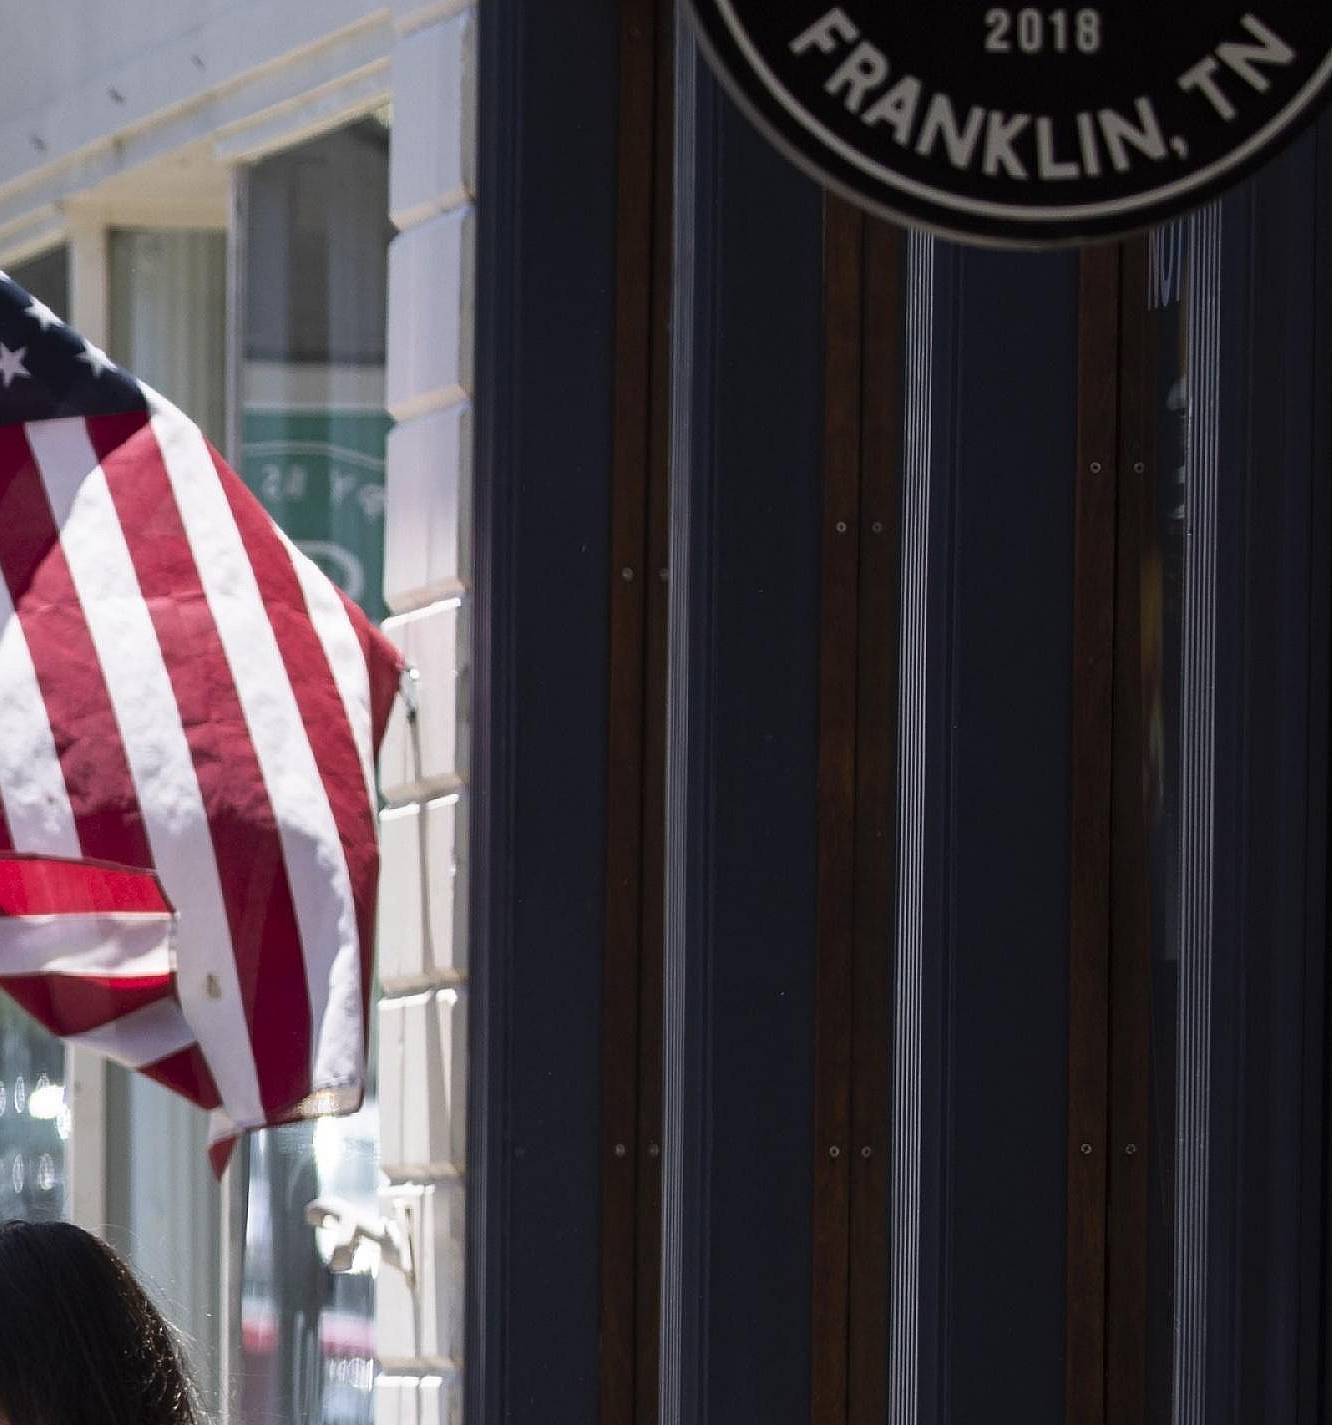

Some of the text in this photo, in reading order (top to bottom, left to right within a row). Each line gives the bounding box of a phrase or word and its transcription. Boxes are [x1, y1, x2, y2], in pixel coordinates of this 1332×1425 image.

[983, 7, 1103, 54] 2018
[789, 7, 1298, 181] FRANKLIN, TN
